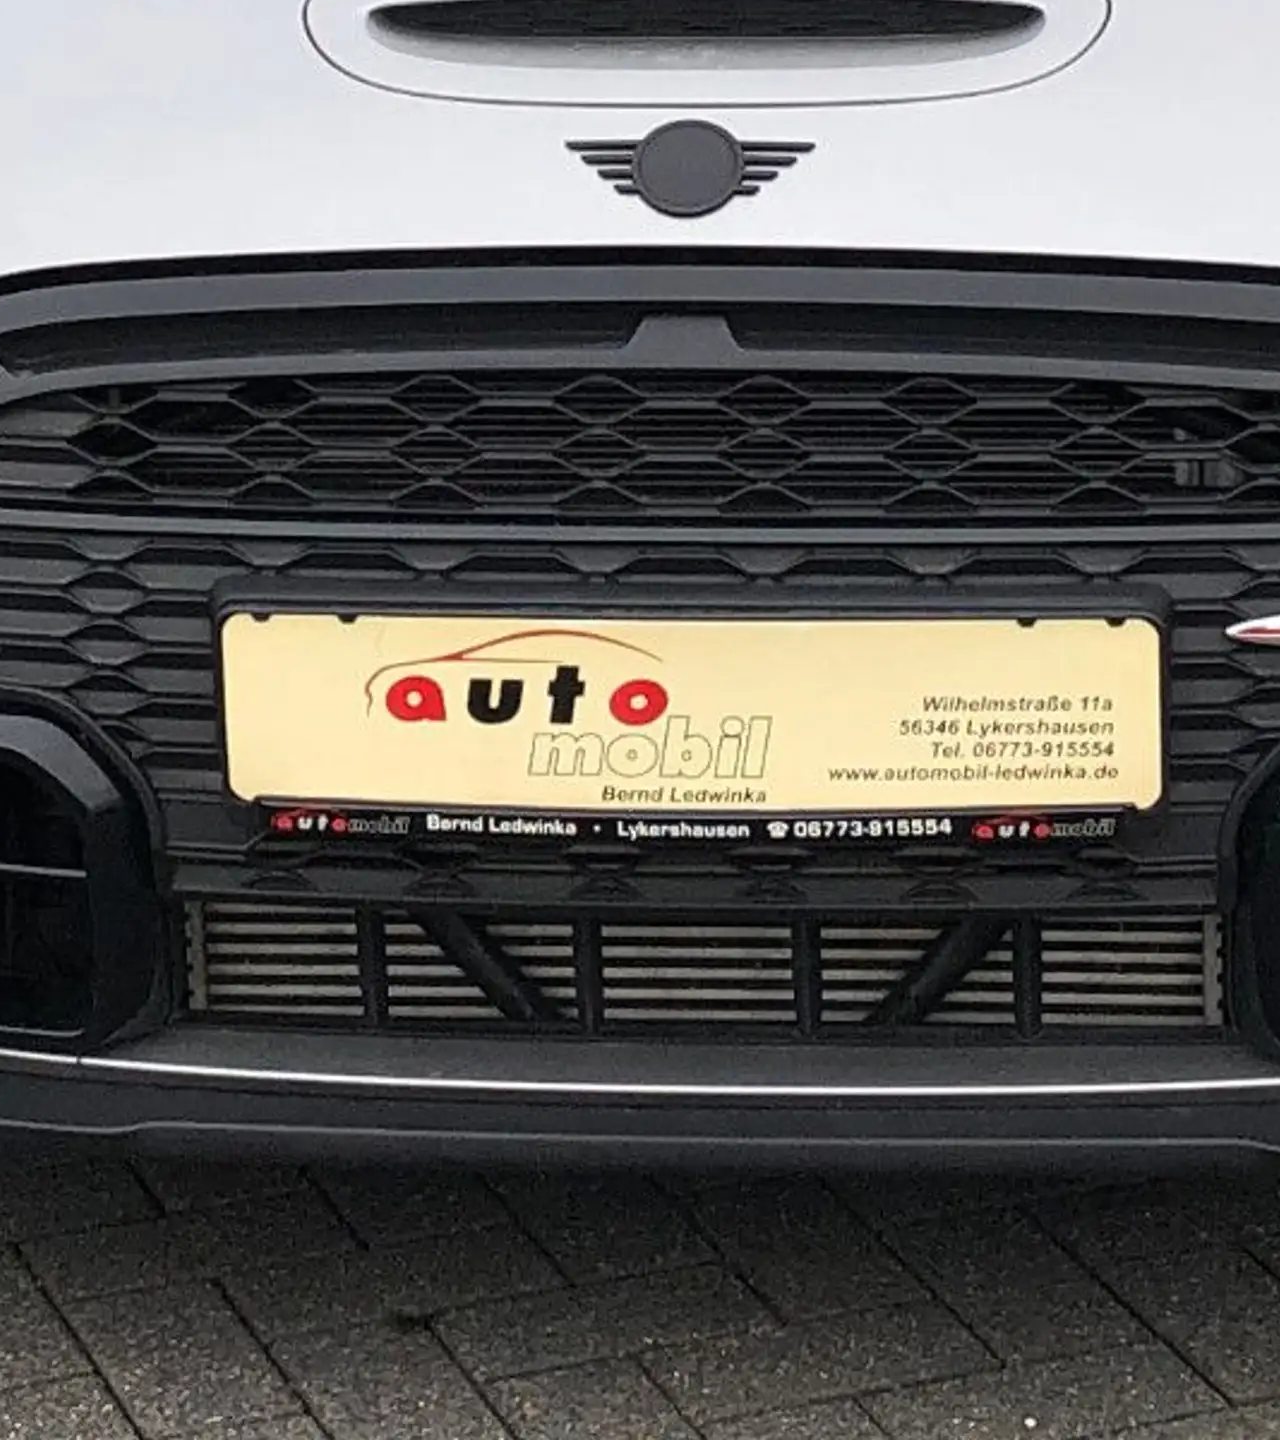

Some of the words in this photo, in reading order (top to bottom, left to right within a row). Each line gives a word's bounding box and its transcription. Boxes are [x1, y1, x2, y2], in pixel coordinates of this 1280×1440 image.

[385, 664, 669, 727] auto
[922, 695, 1072, 713] Wilhelmstraße
[1081, 695, 1113, 713] 11a
[898, 719, 960, 736] 56346
[966, 719, 1115, 739] Lykershausen
[527, 715, 773, 779] mobil
[931, 741, 966, 759] Tel.
[972, 741, 1115, 758] 06773-915554
[828, 764, 1120, 782] www.automobil-ledwinka.de
[601, 785, 664, 803] Bernd
[670, 786, 767, 804] Ledwinka
[425, 813, 484, 833] Bernd
[488, 815, 578, 836] Ledwinka
[616, 820, 751, 841] Lykershausen
[793, 817, 953, 839] 06773-915554
